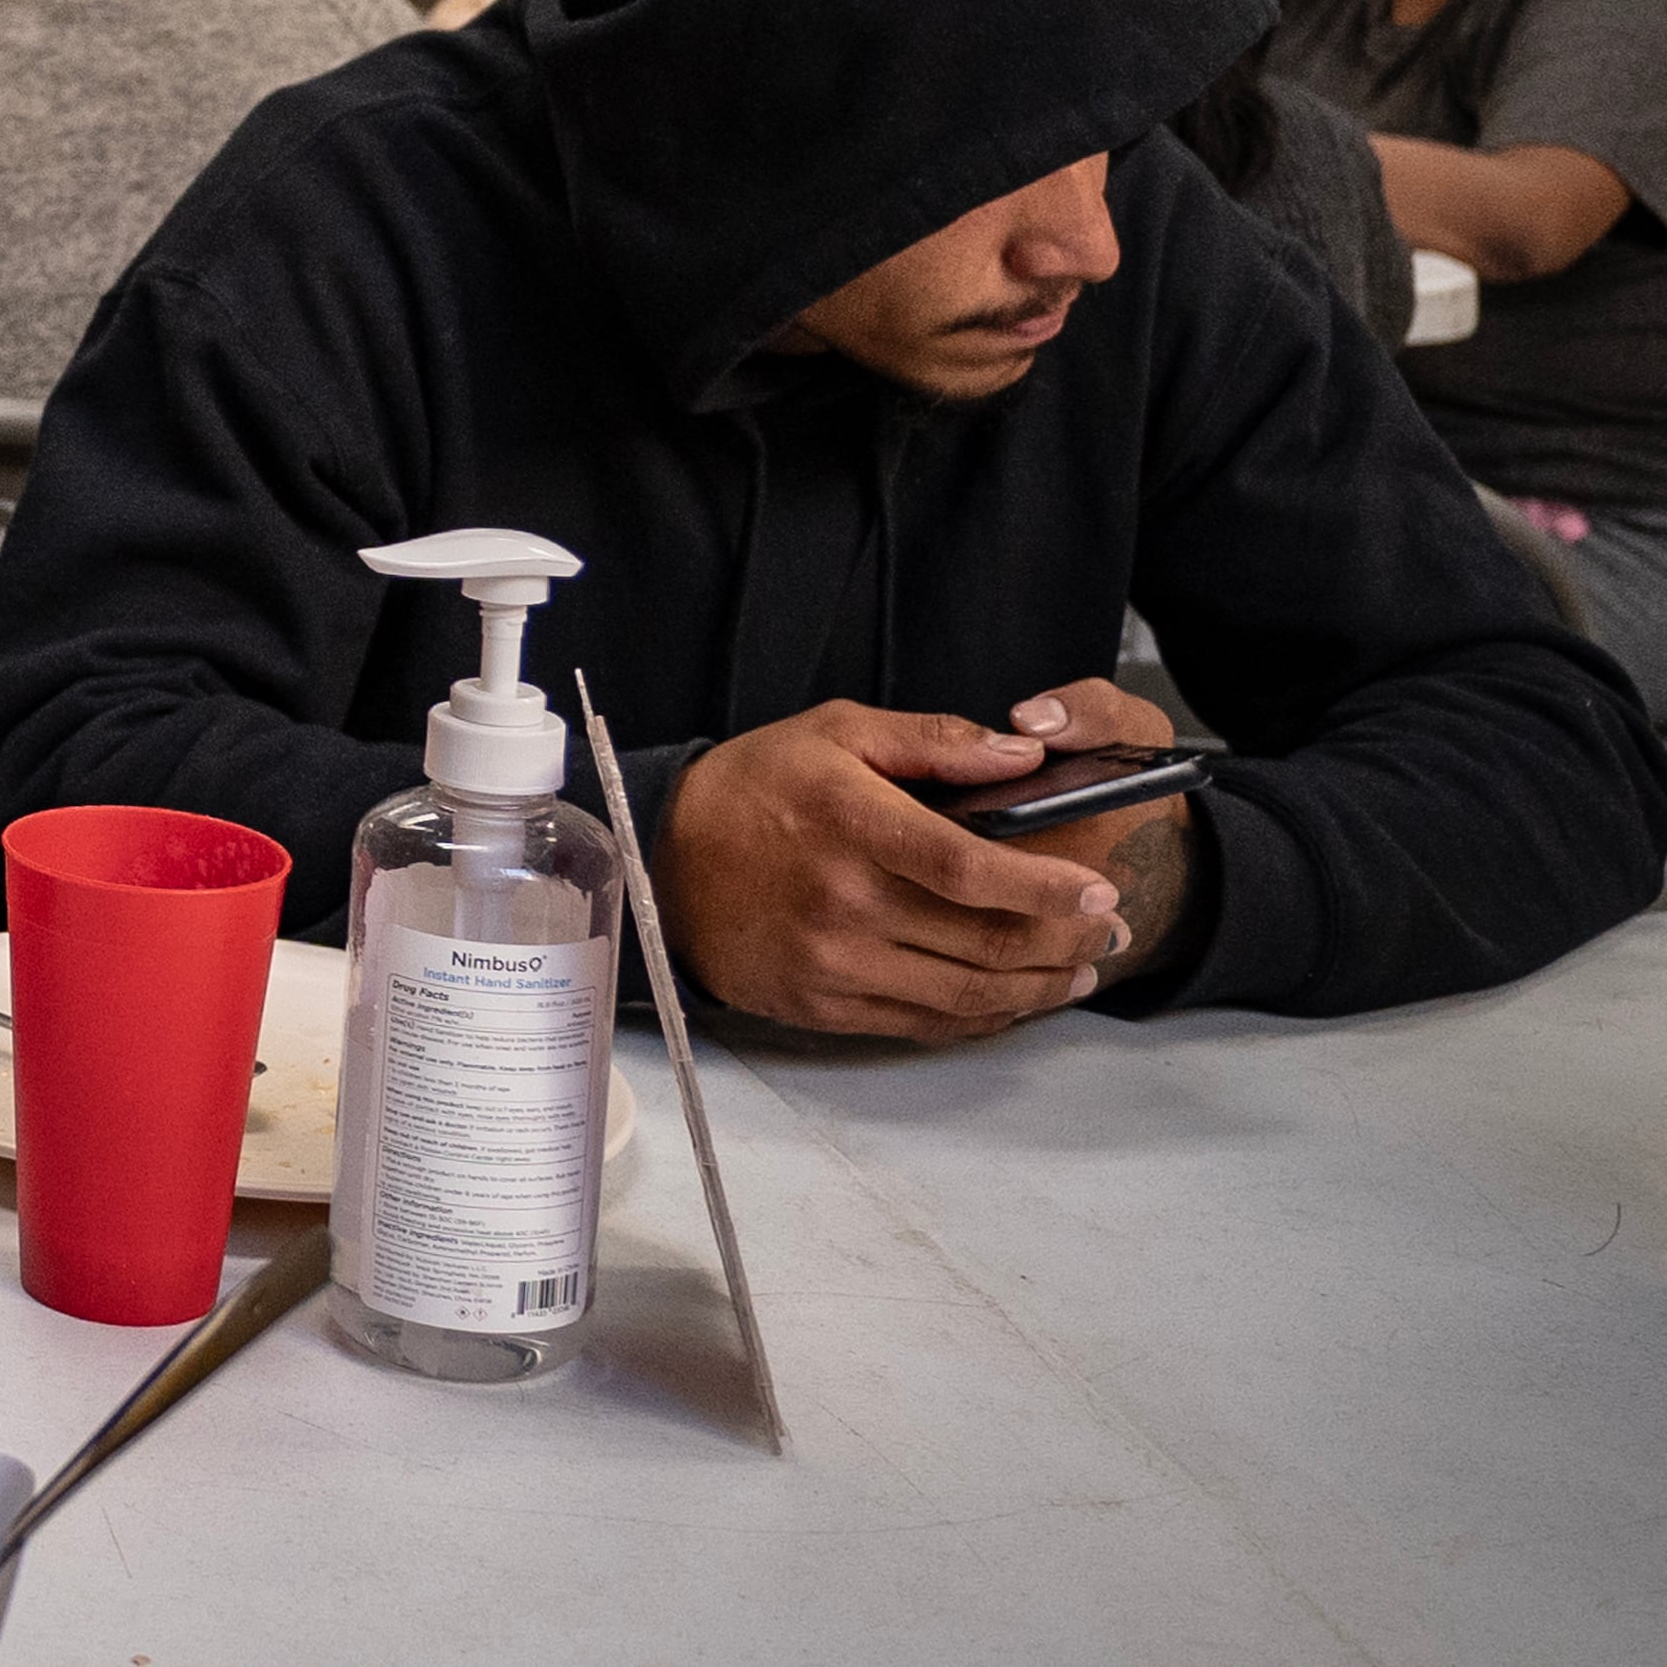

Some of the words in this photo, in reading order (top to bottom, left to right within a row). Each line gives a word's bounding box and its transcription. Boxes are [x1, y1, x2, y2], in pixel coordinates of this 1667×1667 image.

[423, 966, 471, 985] Instant
[475, 976, 512, 989] Hand
[516, 976, 573, 990] Sanitizer
[392, 979, 417, 996] Drug
[419, 986, 450, 1001] Facts
